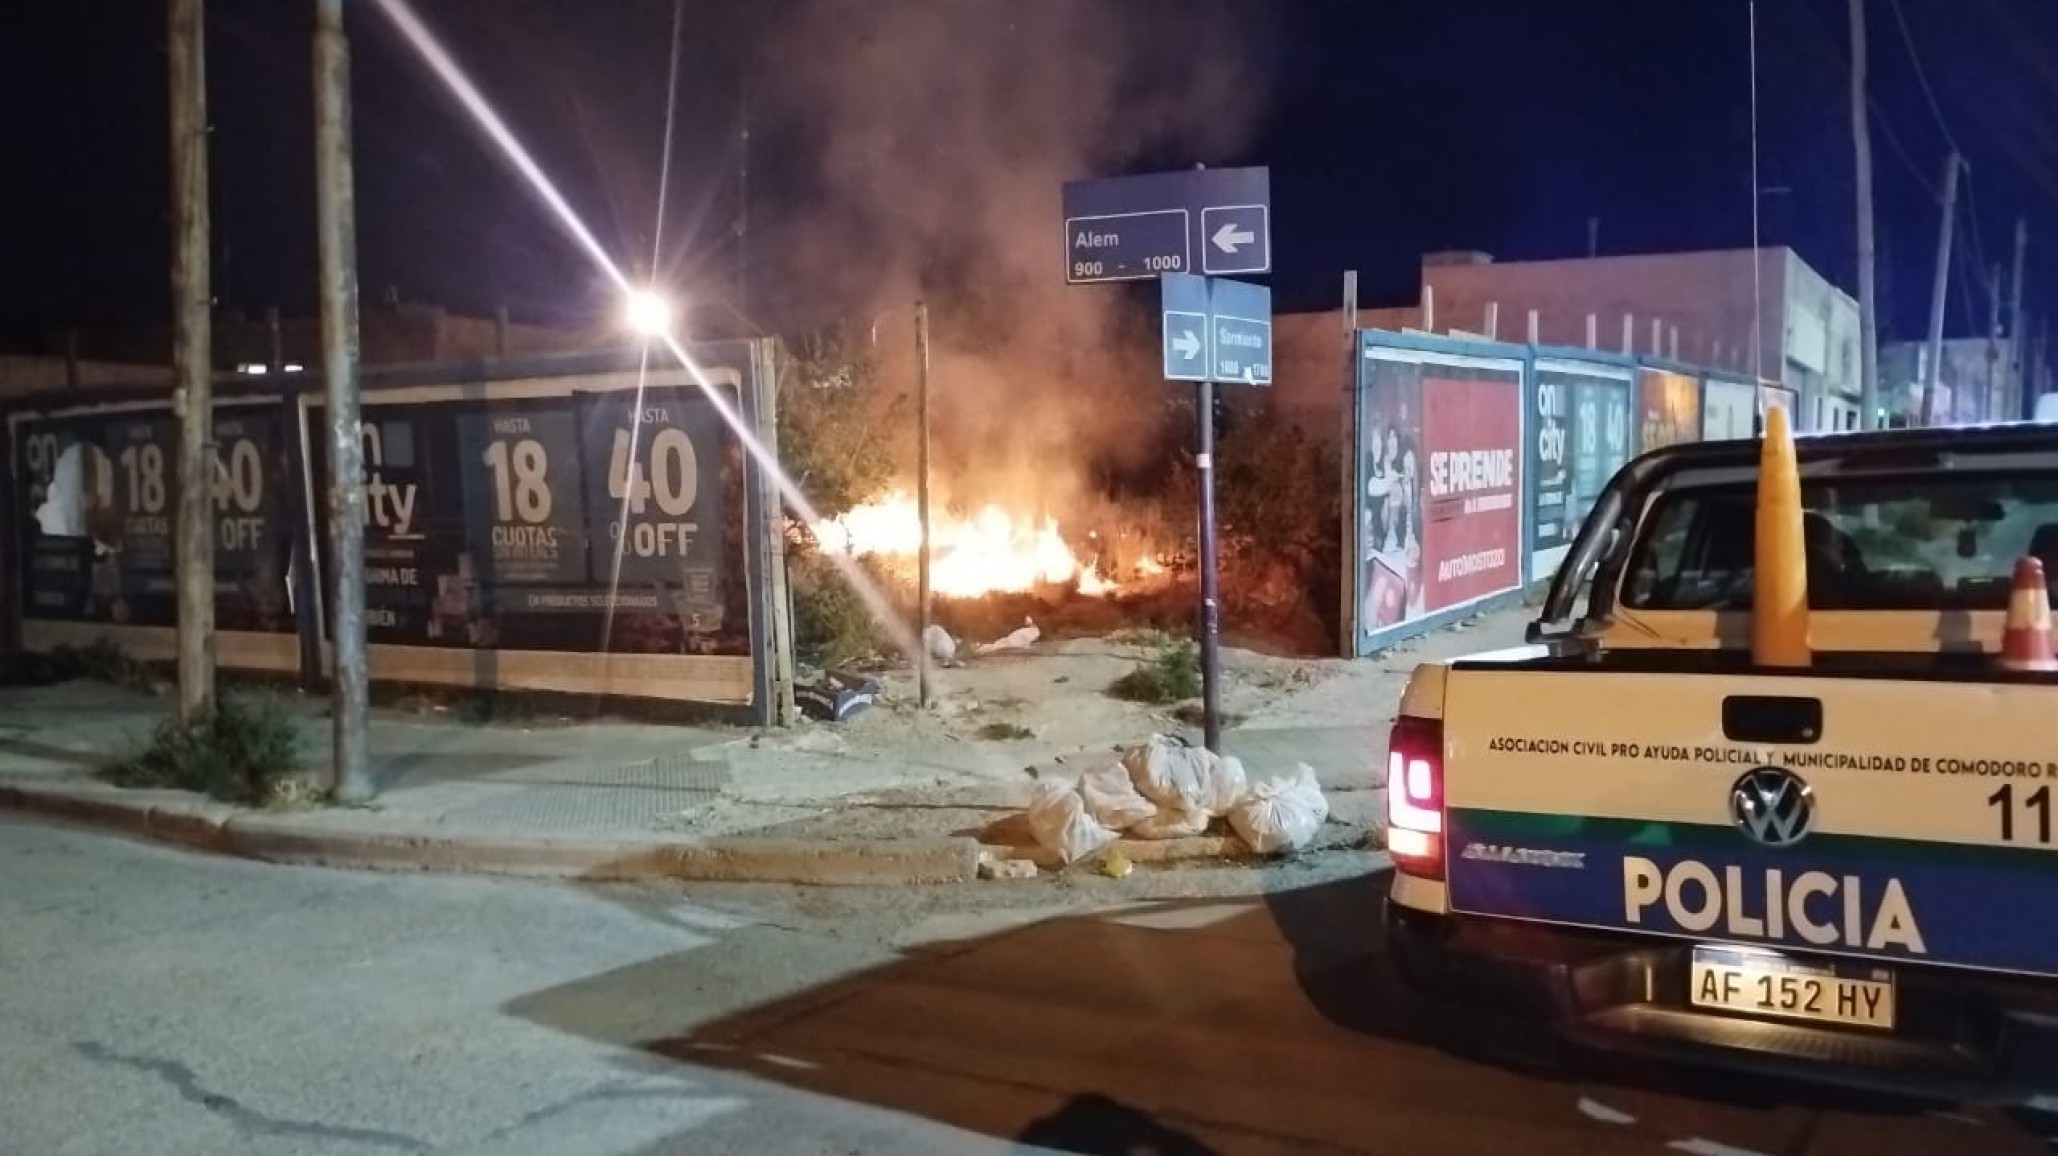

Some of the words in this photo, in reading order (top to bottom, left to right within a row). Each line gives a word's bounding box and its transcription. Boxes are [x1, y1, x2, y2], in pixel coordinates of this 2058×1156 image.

[1075, 232, 1119, 248] Alem
[1075, 262, 1103, 276] 900
[1143, 256, 1181, 270] 1000
[629, 409, 670, 425] HASTA
[1538, 383, 1556, 416] on
[494, 418, 531, 434] HASTA
[1539, 417, 1565, 465] city
[1579, 402, 1596, 454] 18
[1606, 402, 1624, 450] 40
[120, 442, 165, 513] 18
[483, 440, 552, 524] 18
[608, 427, 698, 516] 40
[1430, 451, 1448, 496] SE
[1449, 448, 1513, 493] PRENDE
[221, 518, 265, 549] OFF
[492, 527, 559, 548] CUOTAS
[634, 522, 699, 558] OFF
[1488, 737, 1569, 755] ASOCIACION
[1573, 741, 1607, 757] CIVIL
[1610, 743, 1640, 758] PRO
[1643, 745, 1690, 761] AYUDA
[1694, 747, 1761, 765] POLICIAL
[1766, 751, 1774, 766] Y
[1782, 752, 1905, 772] MUNICIPALIDAD
[1911, 757, 1931, 774] DE
[1936, 758, 2042, 779] COMODORO
[1988, 783, 2051, 843] 11
[1623, 855, 1927, 954] POLICIA
[1701, 968, 1741, 1003] AF
[1757, 975, 1822, 1014] 152
[1837, 982, 1881, 1019] HY
